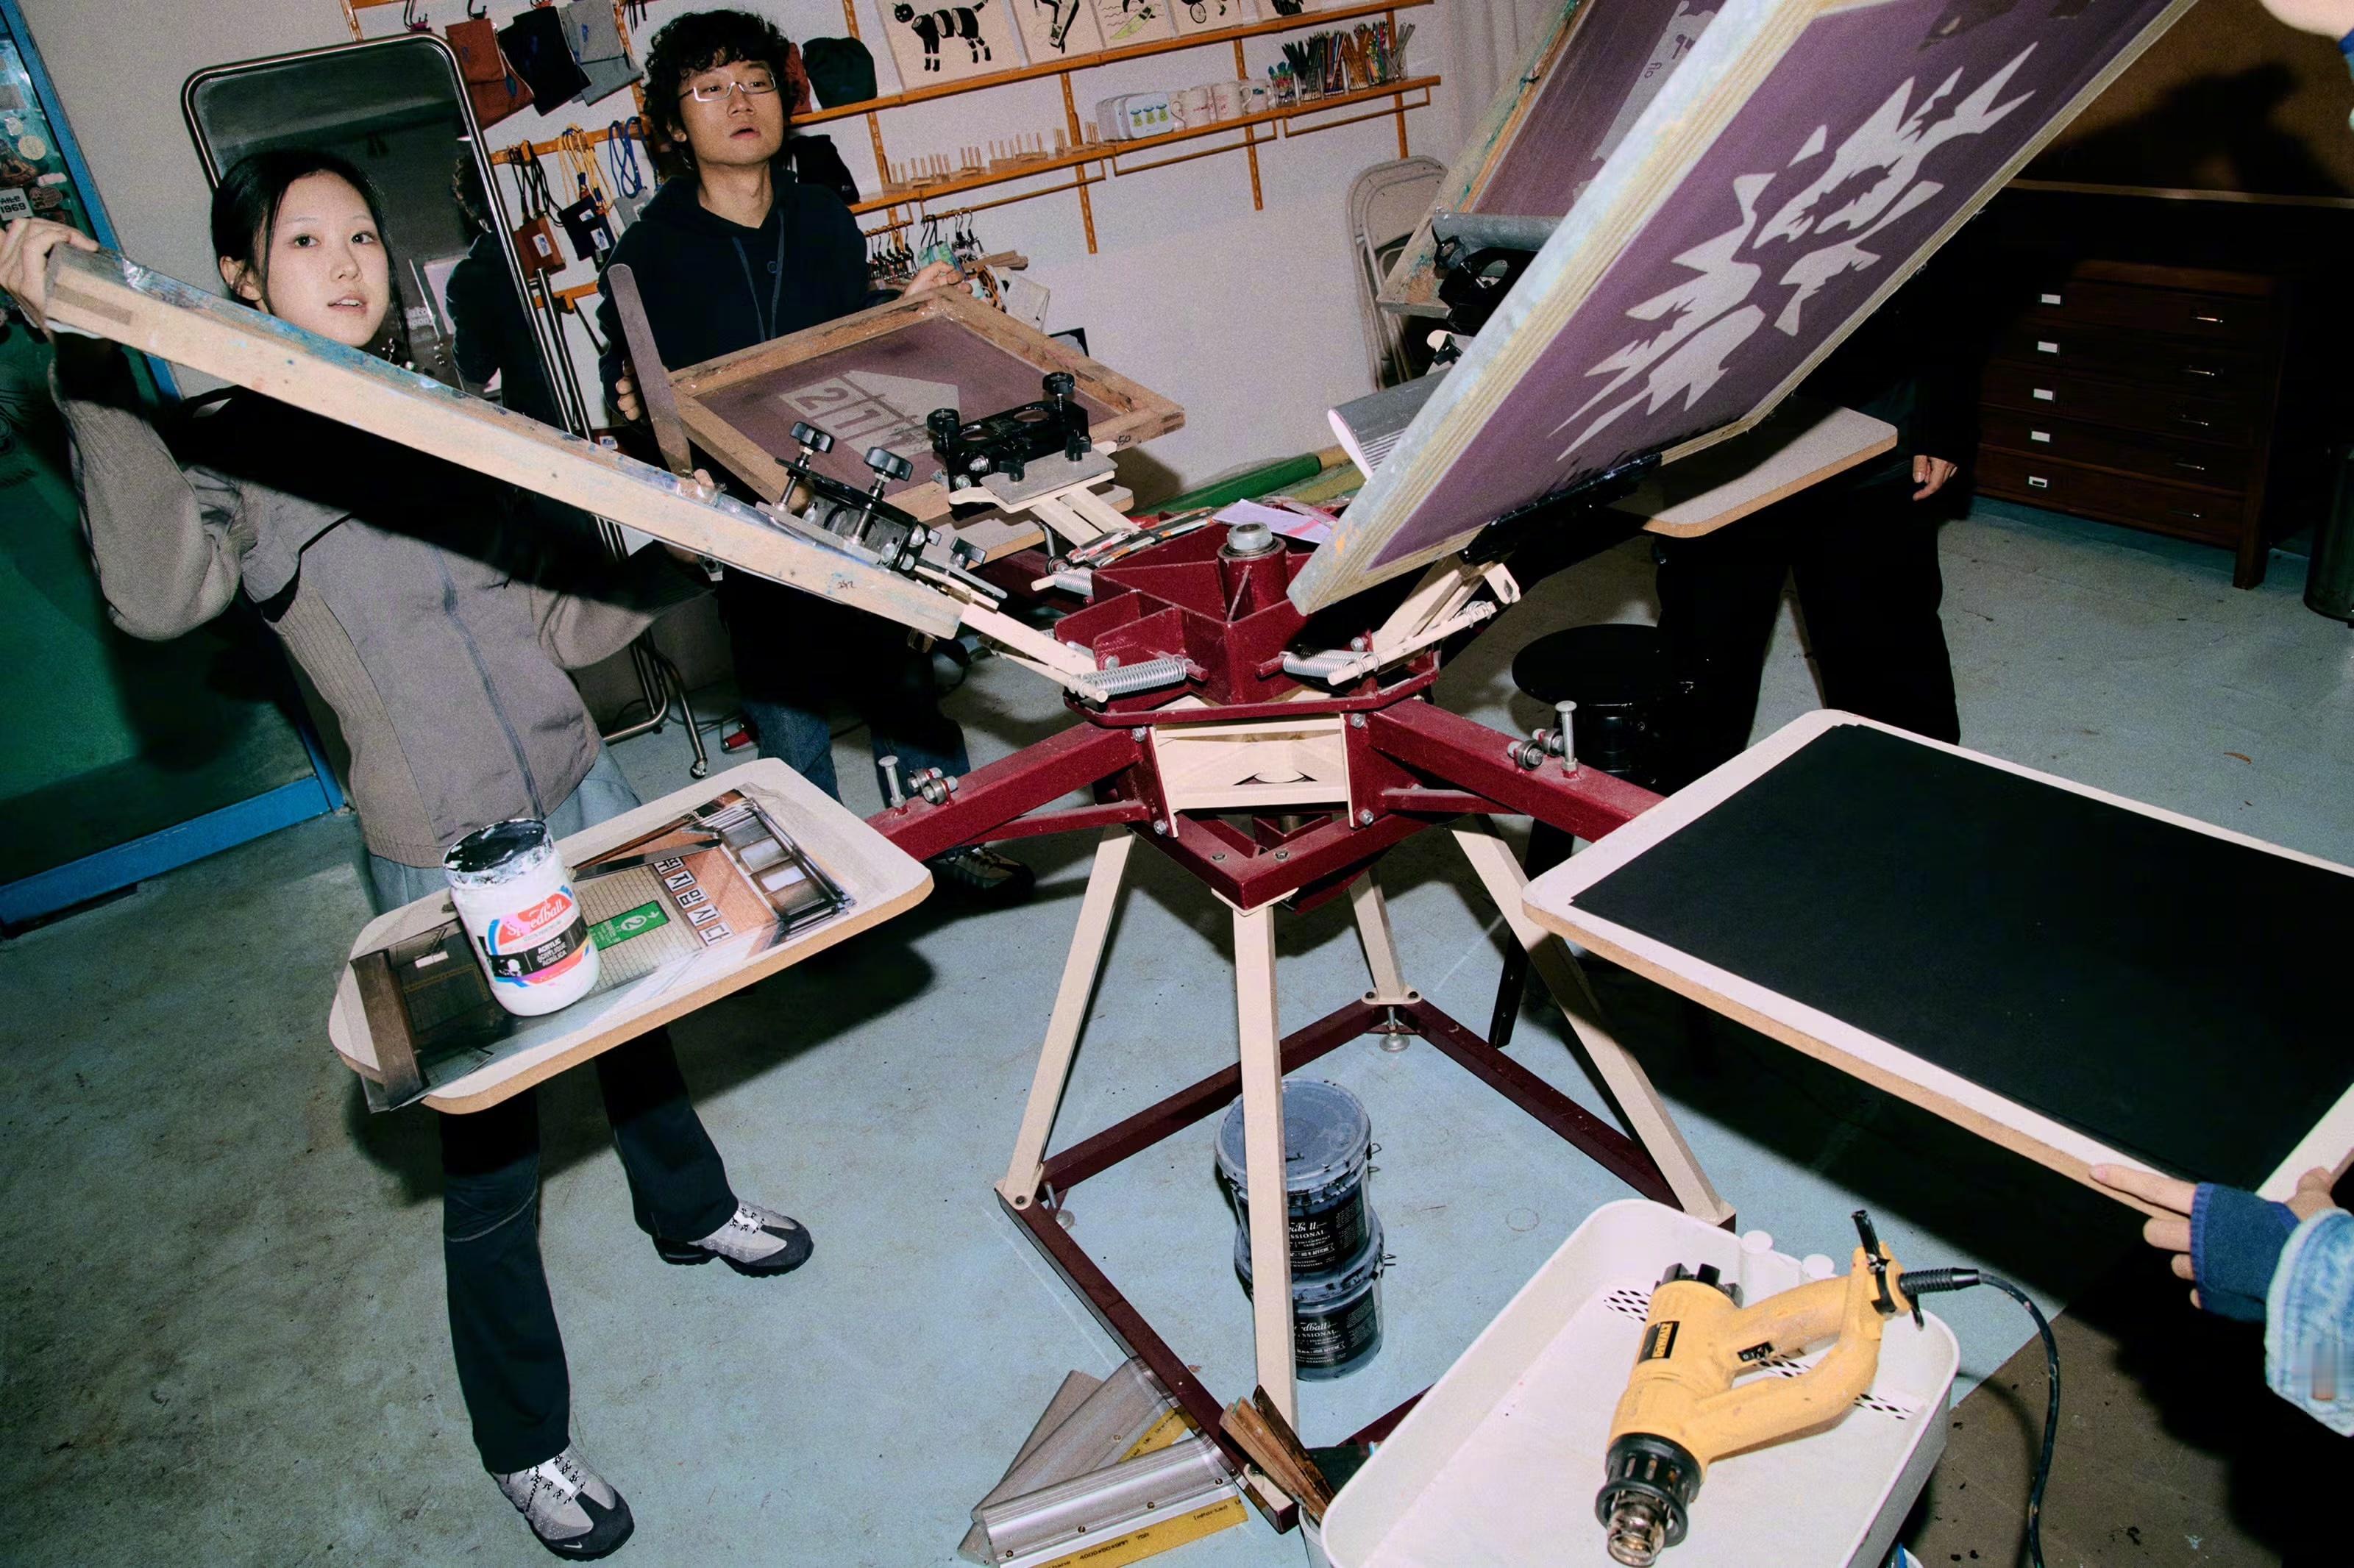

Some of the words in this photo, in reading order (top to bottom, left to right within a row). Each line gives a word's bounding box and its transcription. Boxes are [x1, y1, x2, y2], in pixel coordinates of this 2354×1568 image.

[1, 202, 26, 214] 1969
[506, 899, 566, 937] Sedball
[538, 937, 561, 954] ACRYLIC
